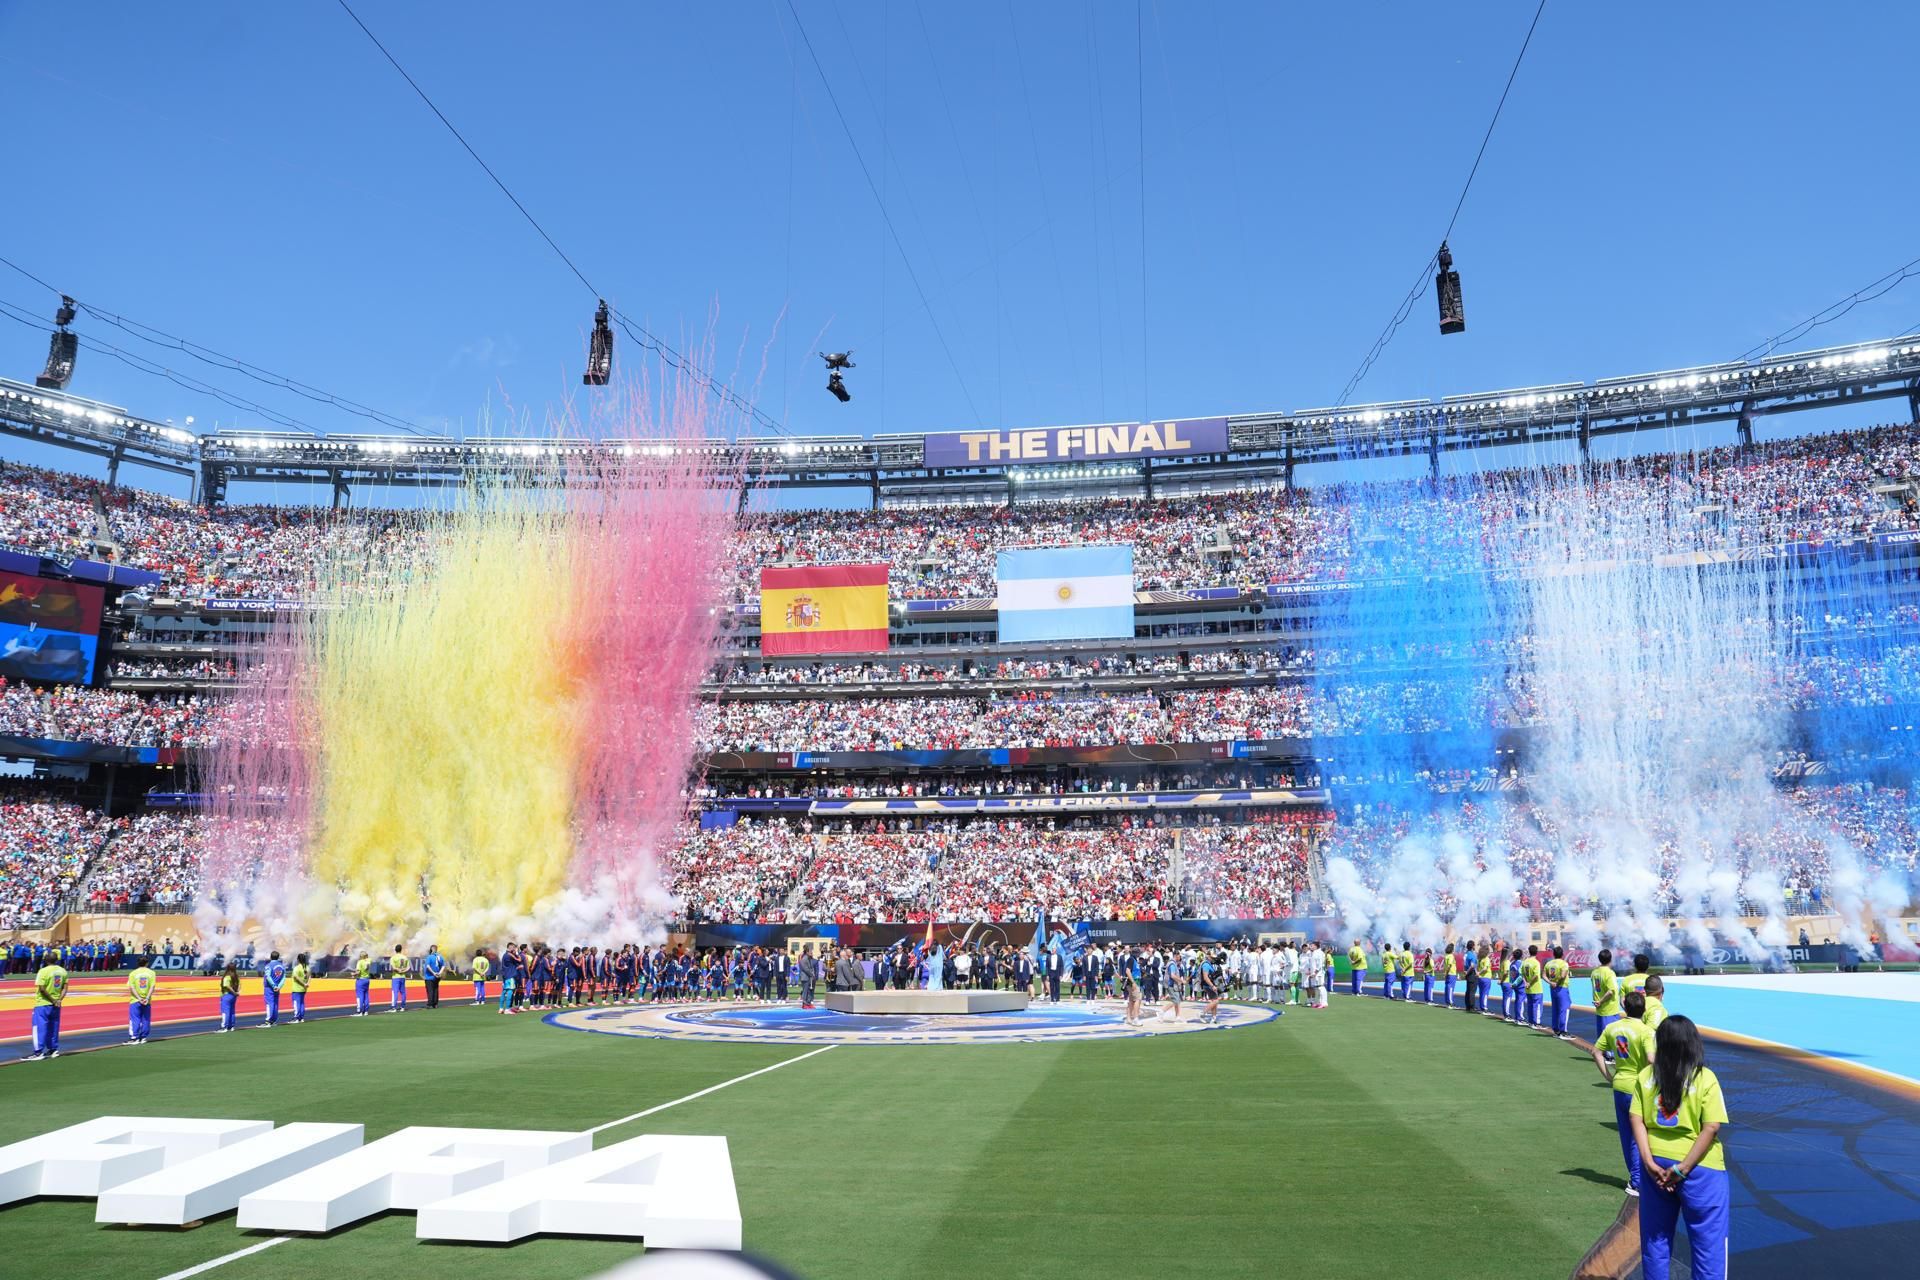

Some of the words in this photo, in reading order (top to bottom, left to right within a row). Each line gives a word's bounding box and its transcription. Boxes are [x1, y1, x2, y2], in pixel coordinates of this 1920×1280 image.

[959, 430, 1048, 461] THE
[1057, 422, 1191, 457] FINAL
[1887, 533, 1920, 542] NEW
[212, 601, 239, 609] NEW
[241, 601, 273, 610] YOR
[275, 602, 301, 610] NEW
[1004, 798, 1056, 807] THE
[1060, 796, 1138, 806] FINAL
[1087, 929, 1118, 937] RGENTINA
[1734, 948, 1811, 961] HDAI
[150, 955, 190, 970] ADI
[0, 1115, 743, 1251] FIFA
